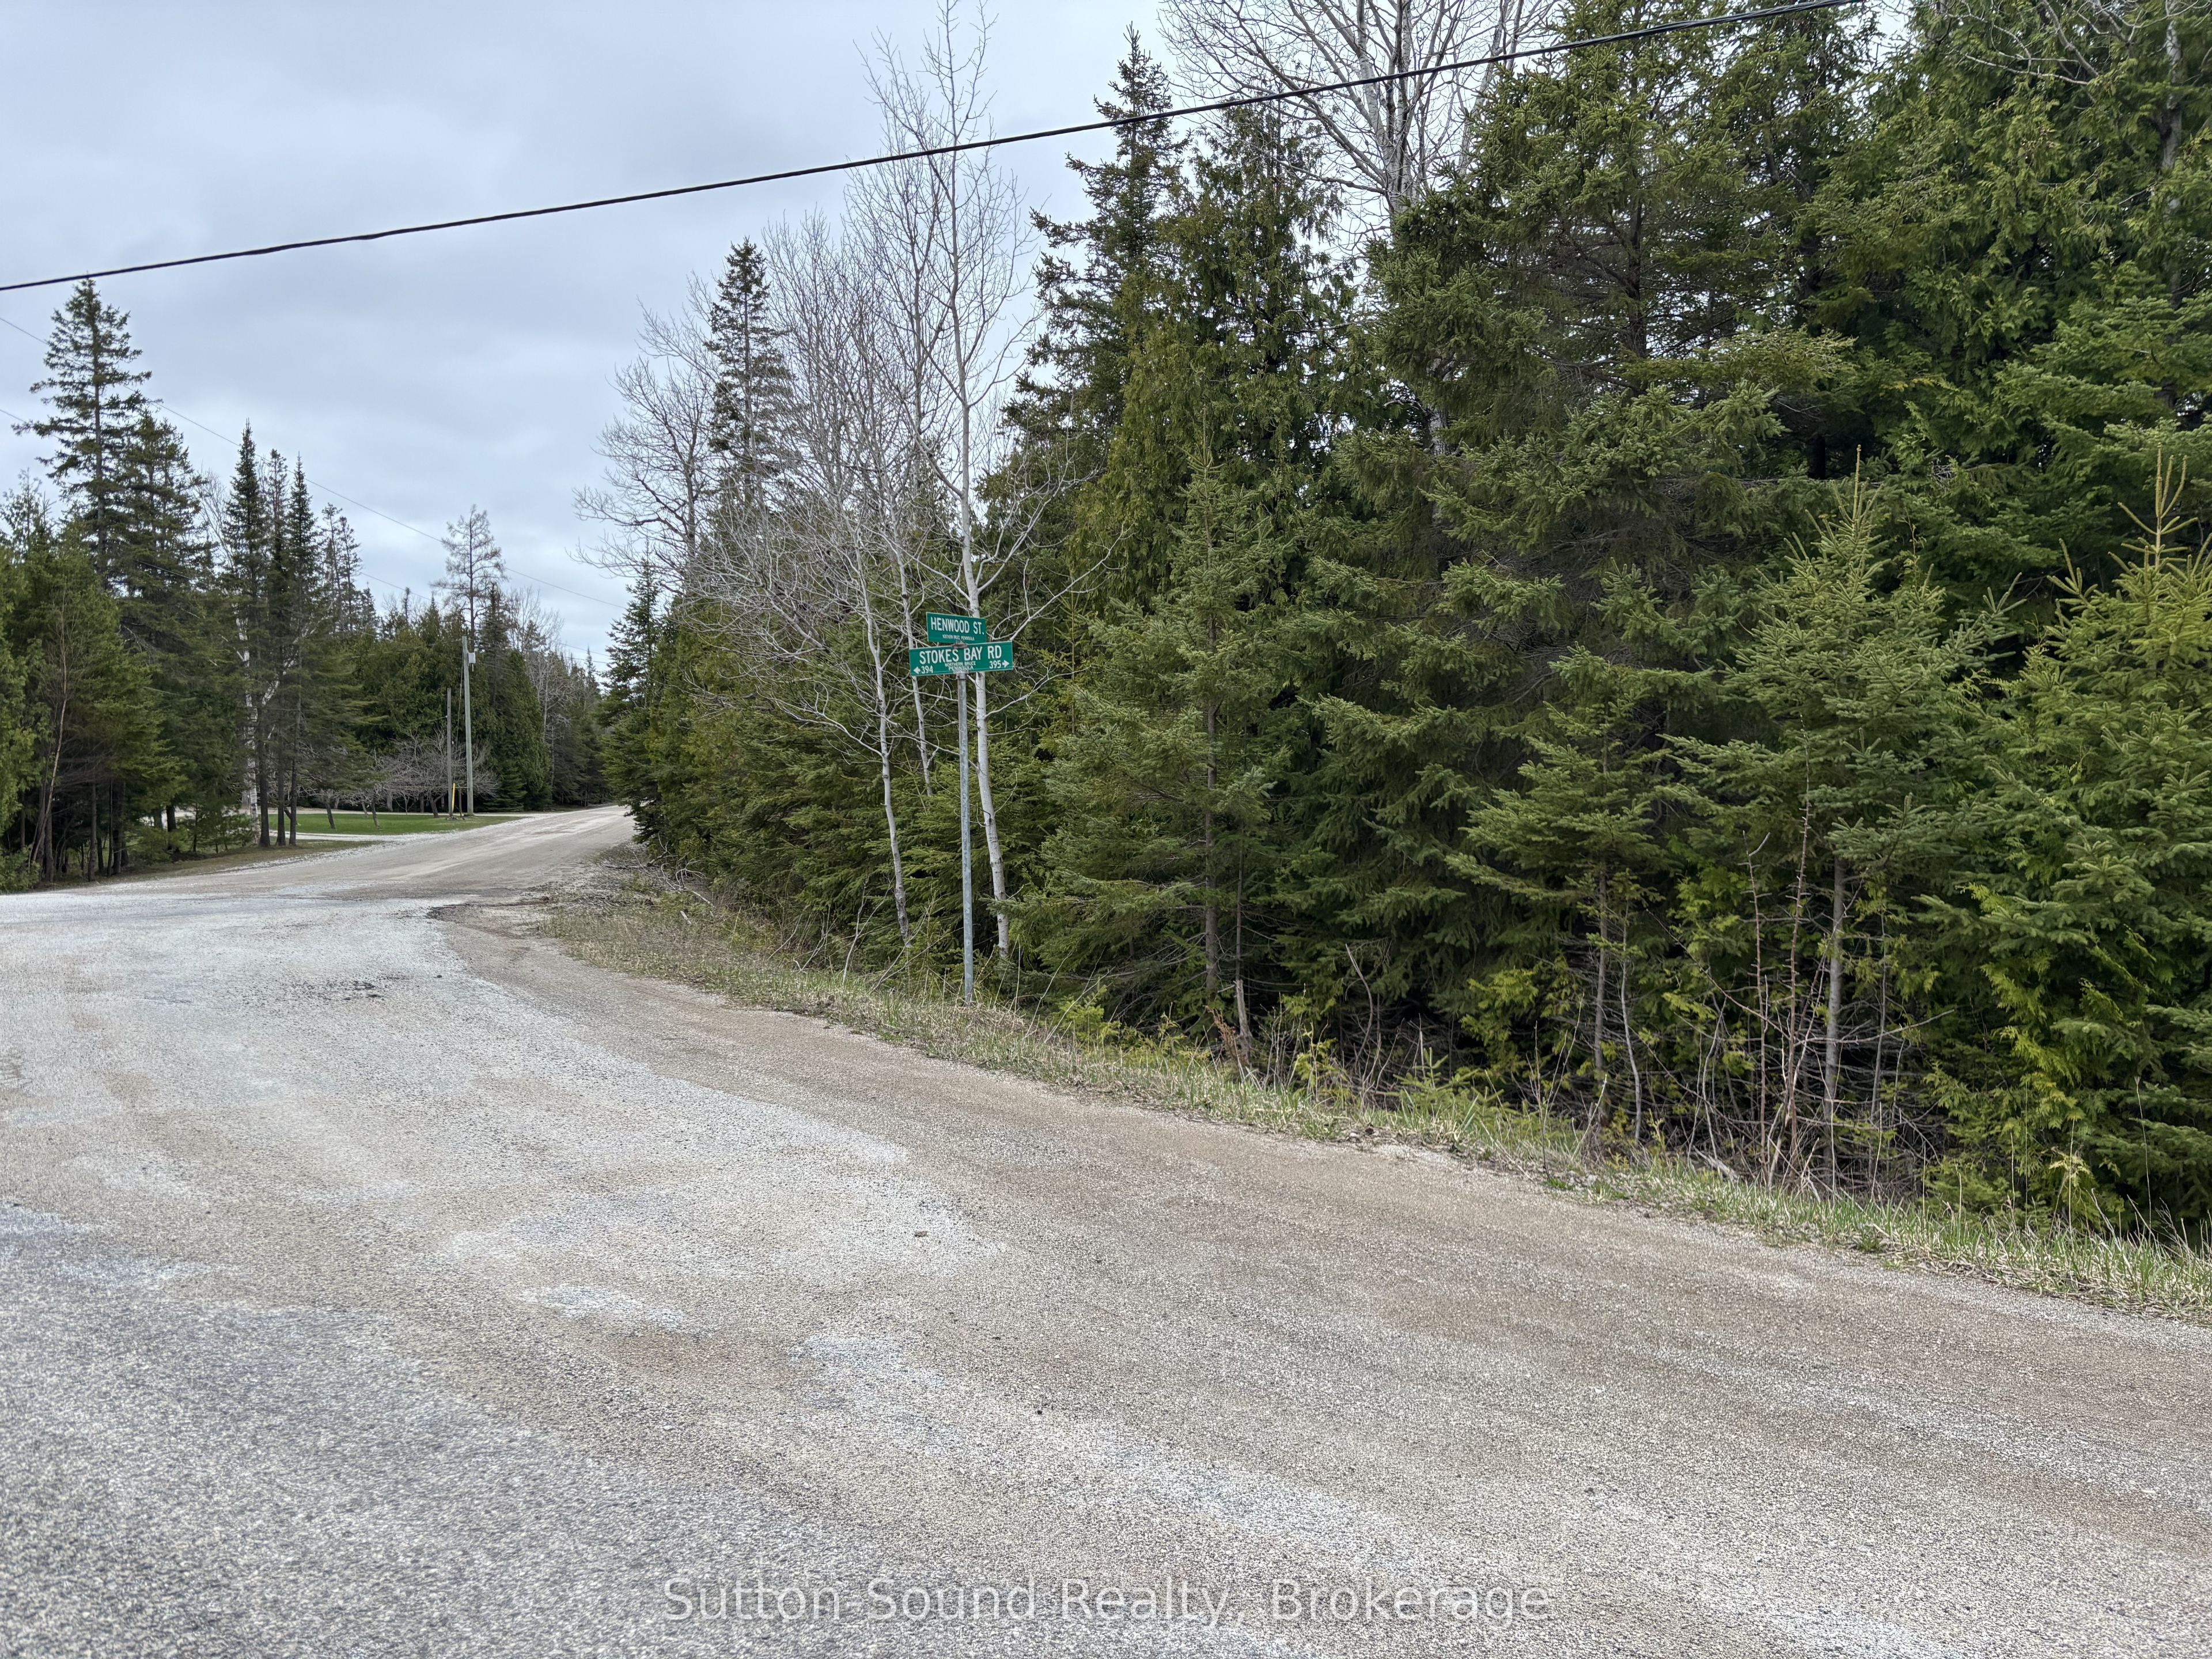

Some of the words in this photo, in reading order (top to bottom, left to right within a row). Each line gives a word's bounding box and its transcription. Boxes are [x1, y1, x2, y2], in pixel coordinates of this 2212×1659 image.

[931, 617, 969, 633] HENWOOD
[973, 621, 984, 635] ST.
[919, 649, 959, 665] STOKES
[964, 646, 982, 661] BAY
[987, 645, 1002, 659] RD
[921, 665, 933, 673] 394
[989, 660, 1001, 669] 395
